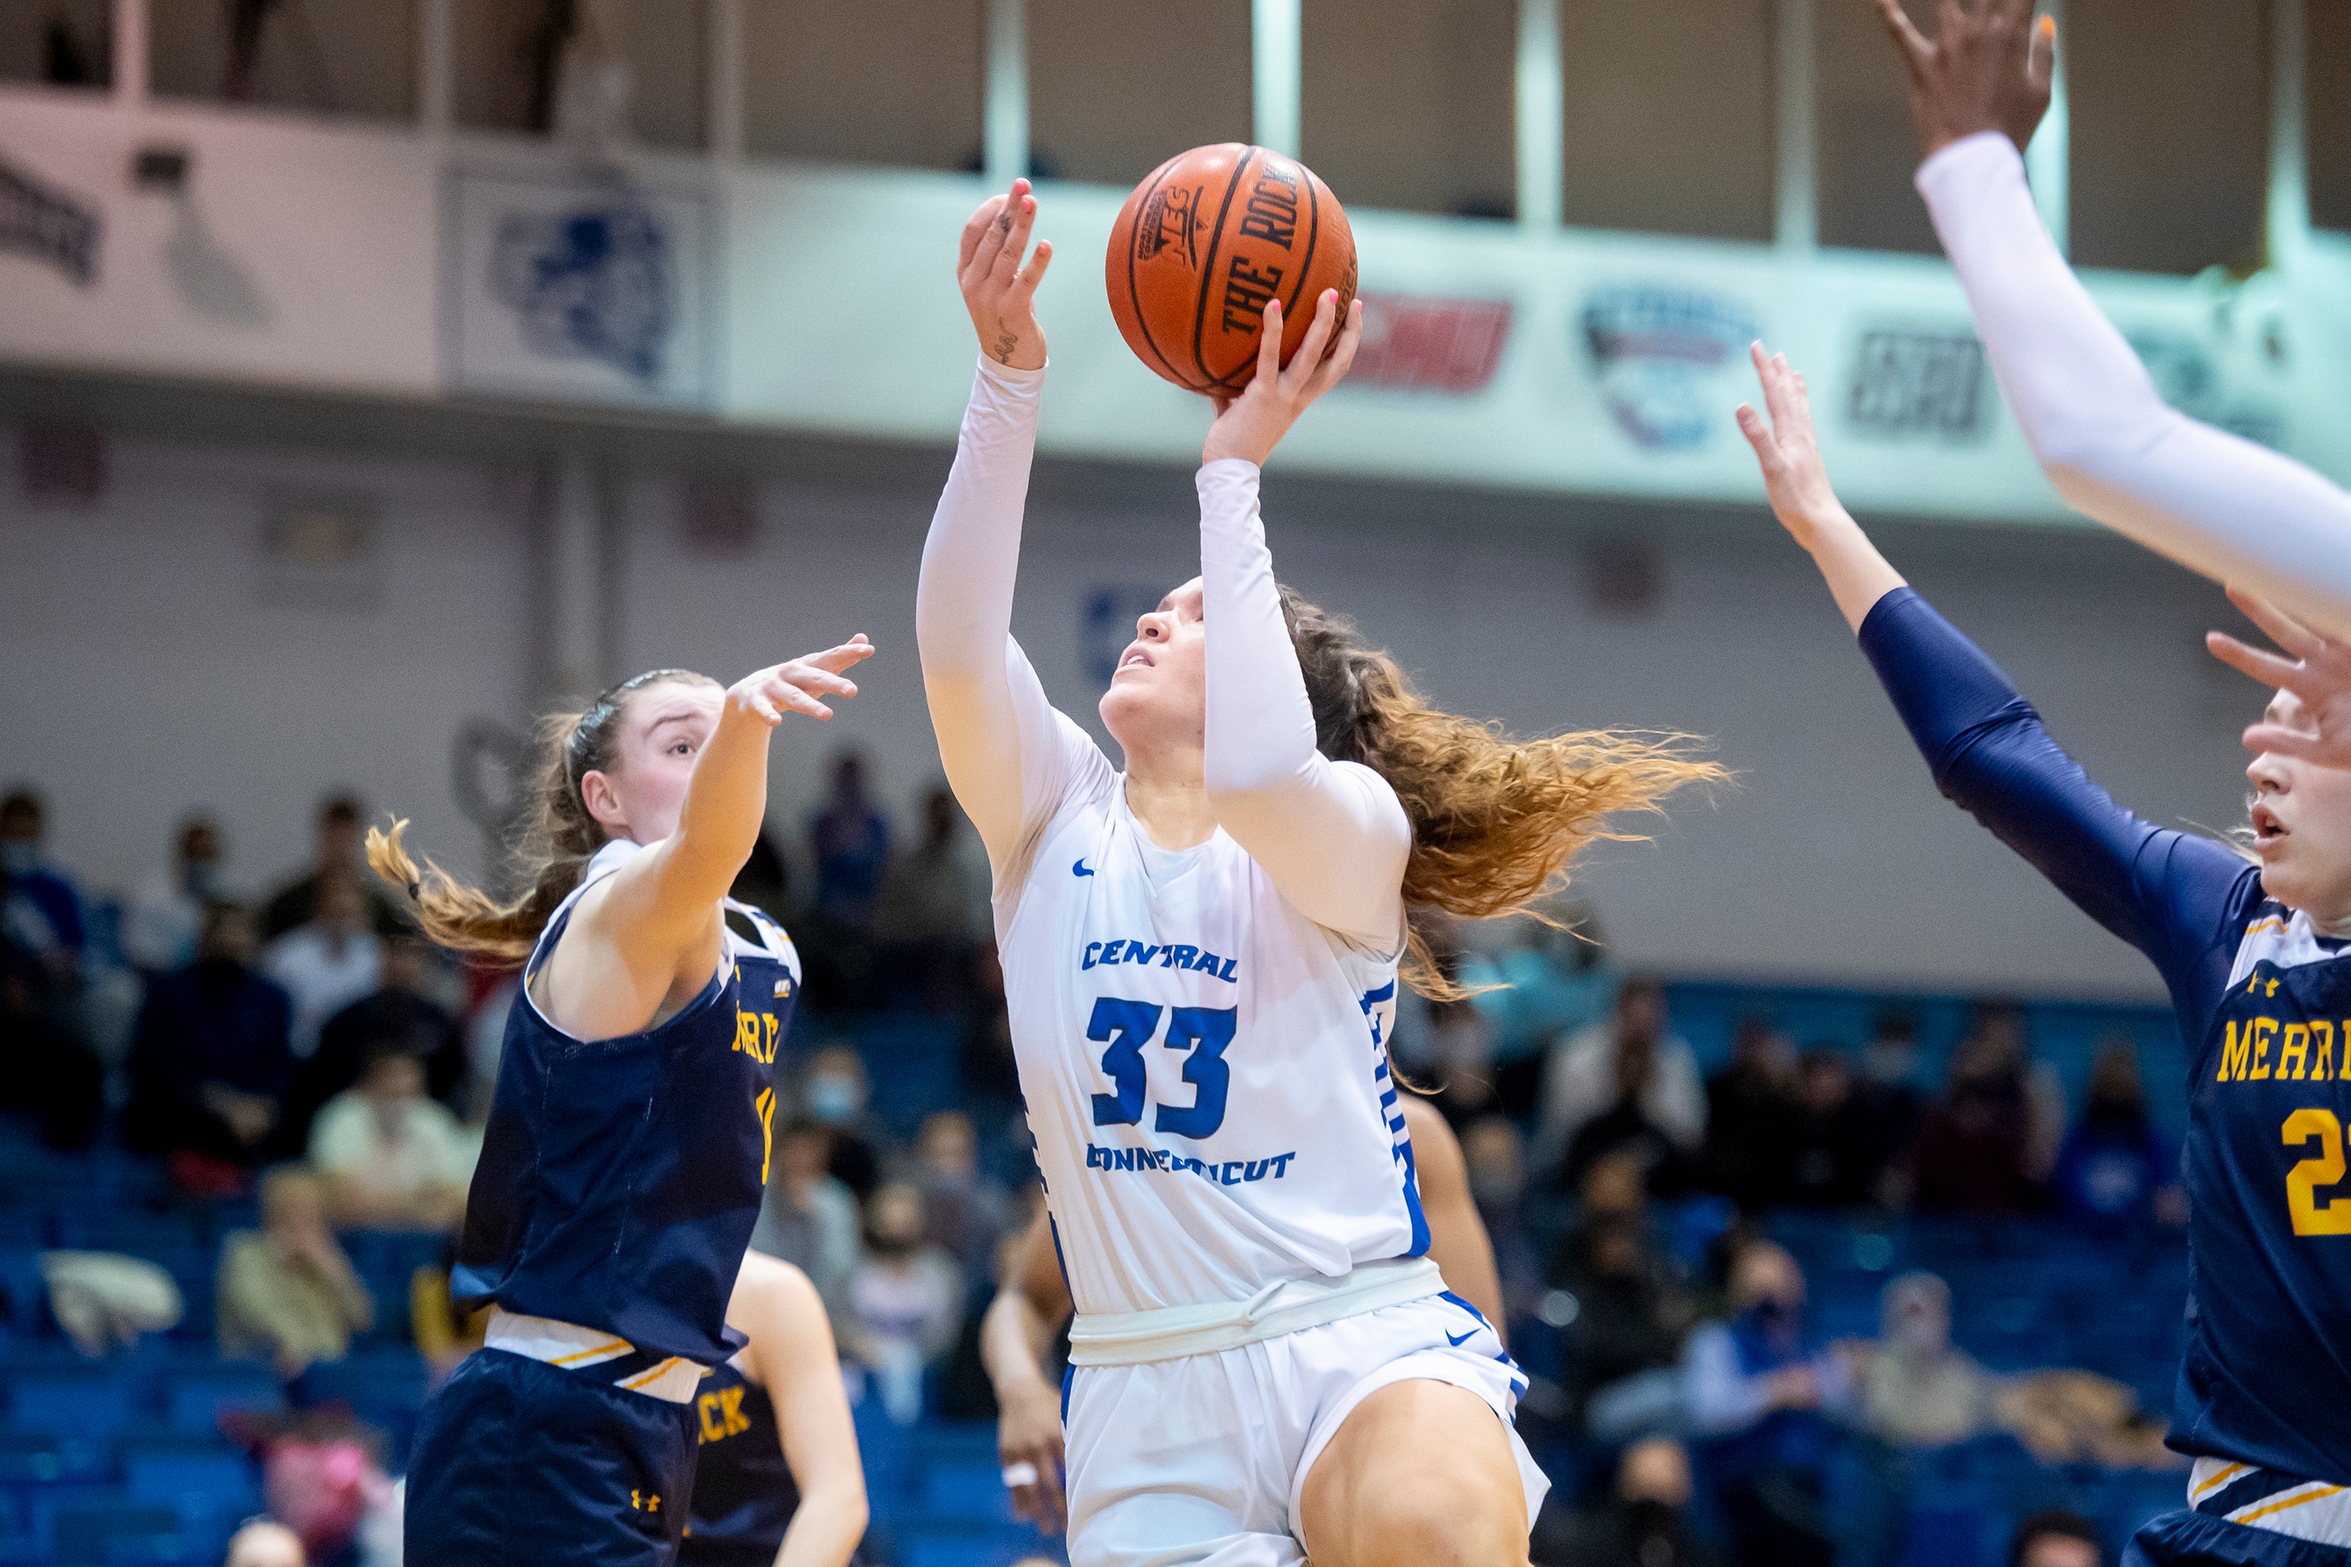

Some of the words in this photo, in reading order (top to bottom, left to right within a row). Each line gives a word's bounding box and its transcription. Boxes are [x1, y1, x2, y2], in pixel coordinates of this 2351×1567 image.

[1239, 163, 1298, 252] ROCK
[1222, 256, 1284, 335] THE
[1082, 939, 1237, 983] CENTRAL
[1086, 997, 1238, 1140] 33
[2281, 1109, 2351, 1237] 2
[698, 1386, 750, 1445] CK
